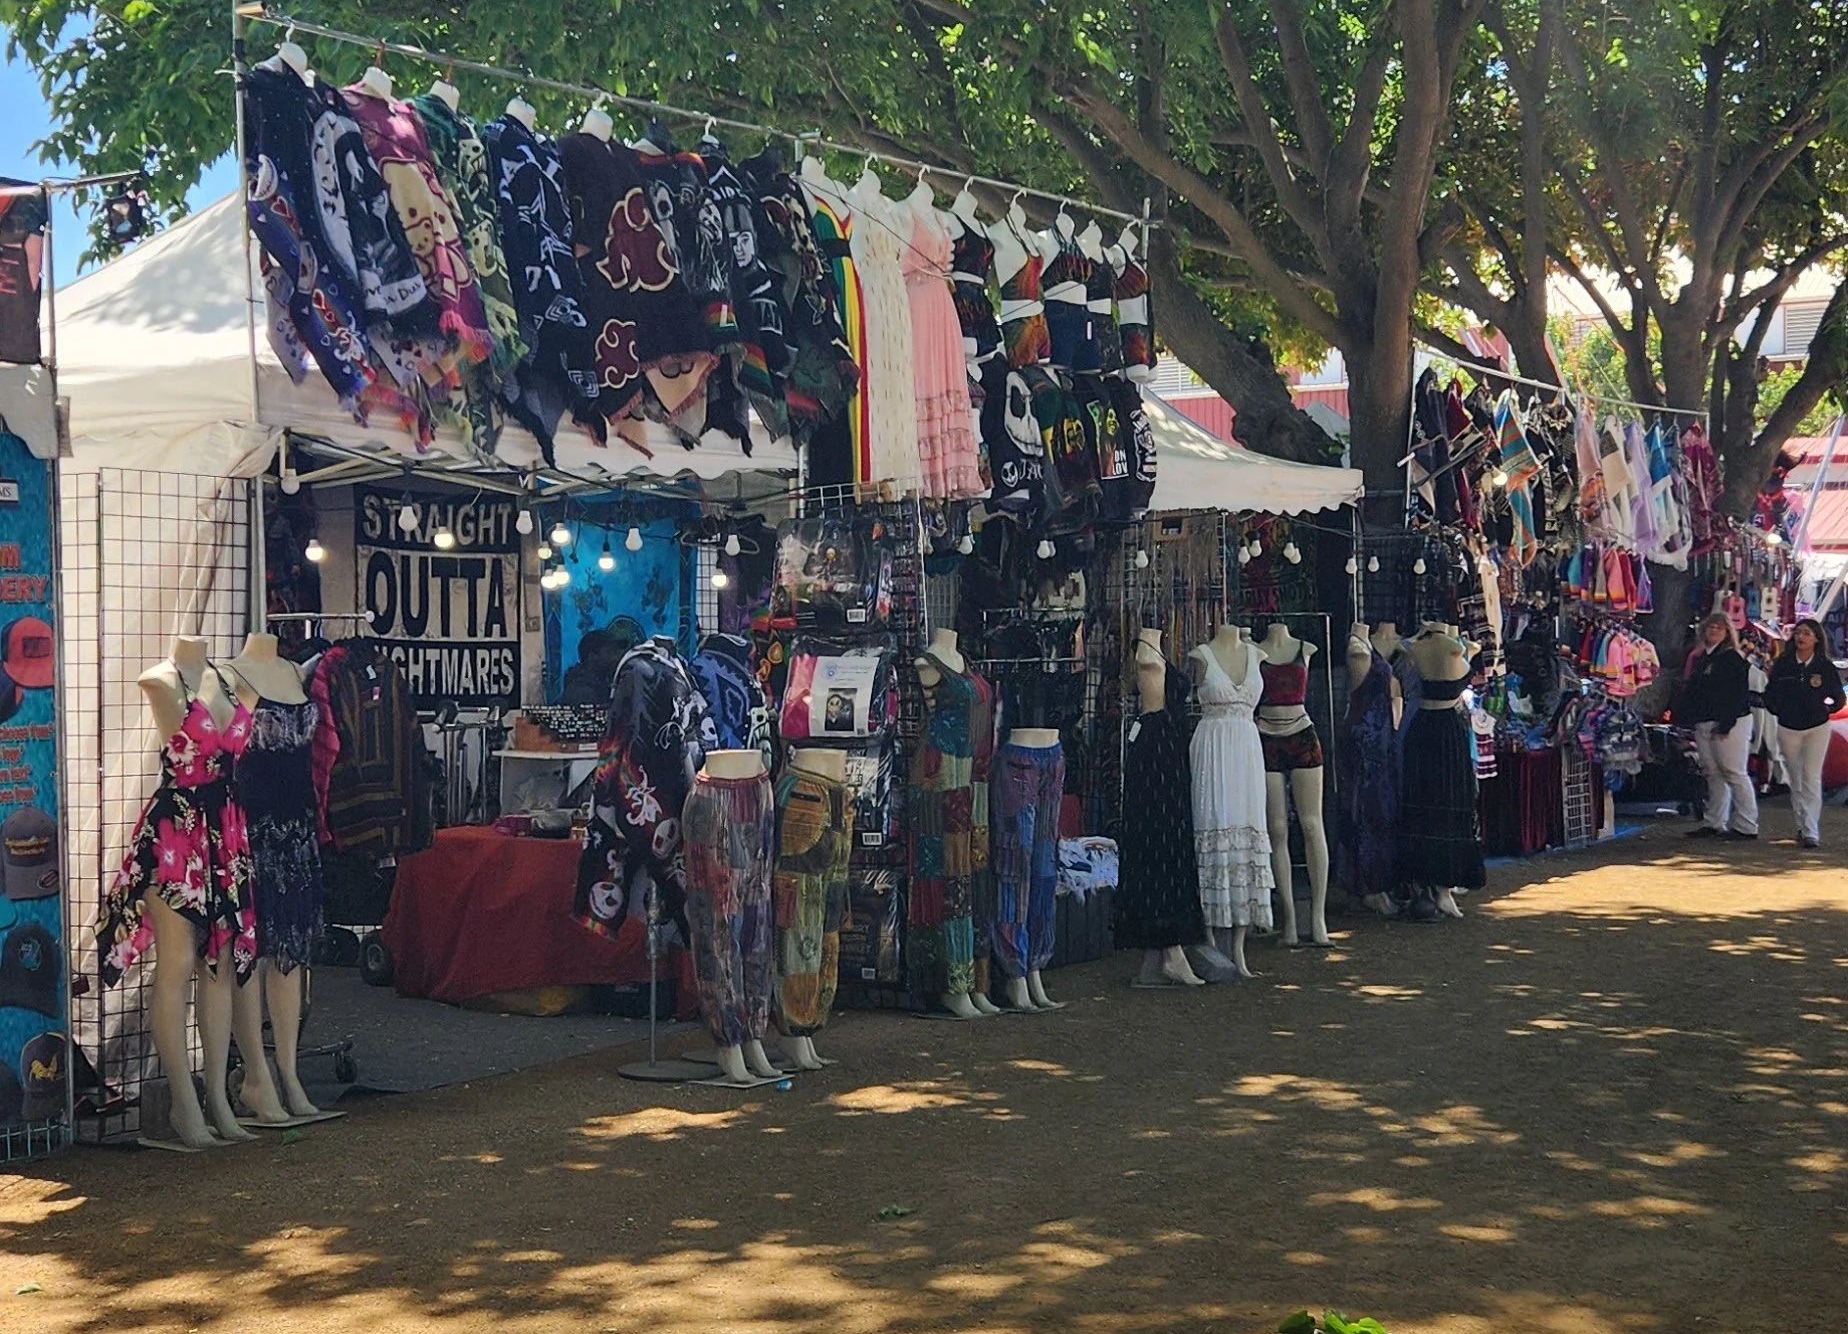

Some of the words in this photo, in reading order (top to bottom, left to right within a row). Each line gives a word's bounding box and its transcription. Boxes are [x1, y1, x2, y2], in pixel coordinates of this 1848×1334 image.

[363, 494, 512, 546] STRAIGHT
[0, 543, 20, 568] M
[0, 574, 47, 603] ERY
[366, 550, 508, 638] OUTTA
[374, 644, 515, 696] GHTMARES
